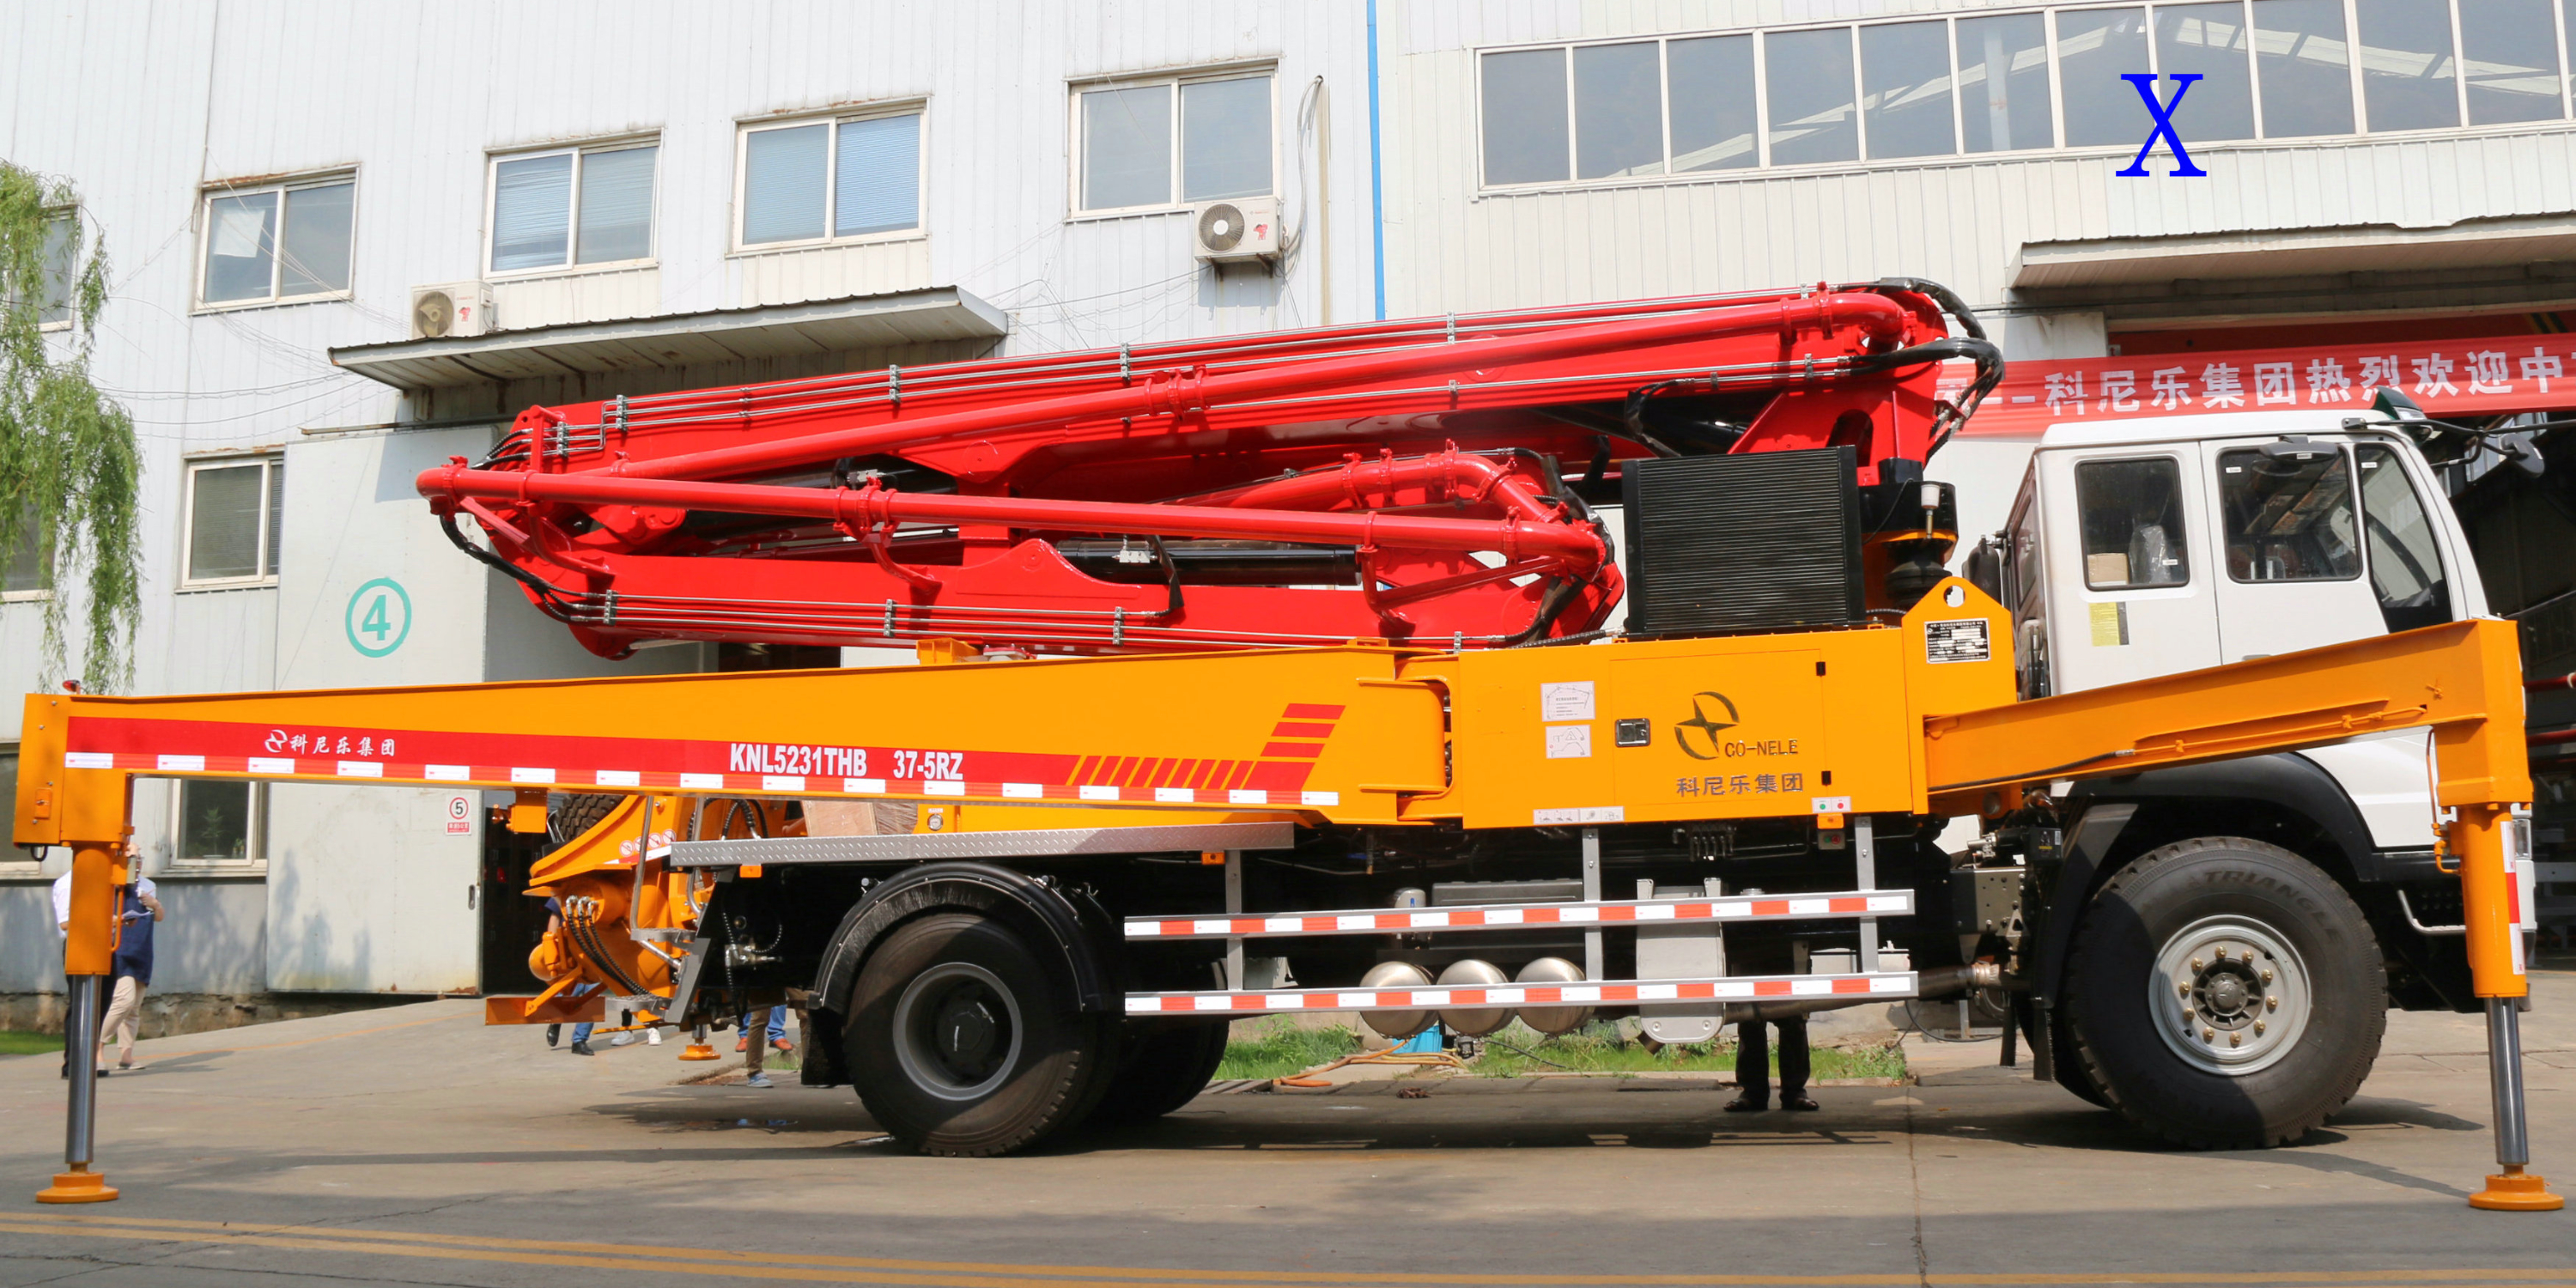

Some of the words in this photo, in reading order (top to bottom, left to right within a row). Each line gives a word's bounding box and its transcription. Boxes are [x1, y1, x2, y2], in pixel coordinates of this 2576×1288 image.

[361, 594, 391, 641] 4
[290, 734, 395, 756] 科尼乐集团
[1725, 738, 1798, 757] CO-NELE
[730, 743, 867, 776] KNL5231THB
[893, 750, 963, 781] 37-5RZ
[1676, 773, 1803, 797] 科尼乐集团
[455, 801, 464, 815] 5
[2204, 870, 2344, 945] TRIANGLE
